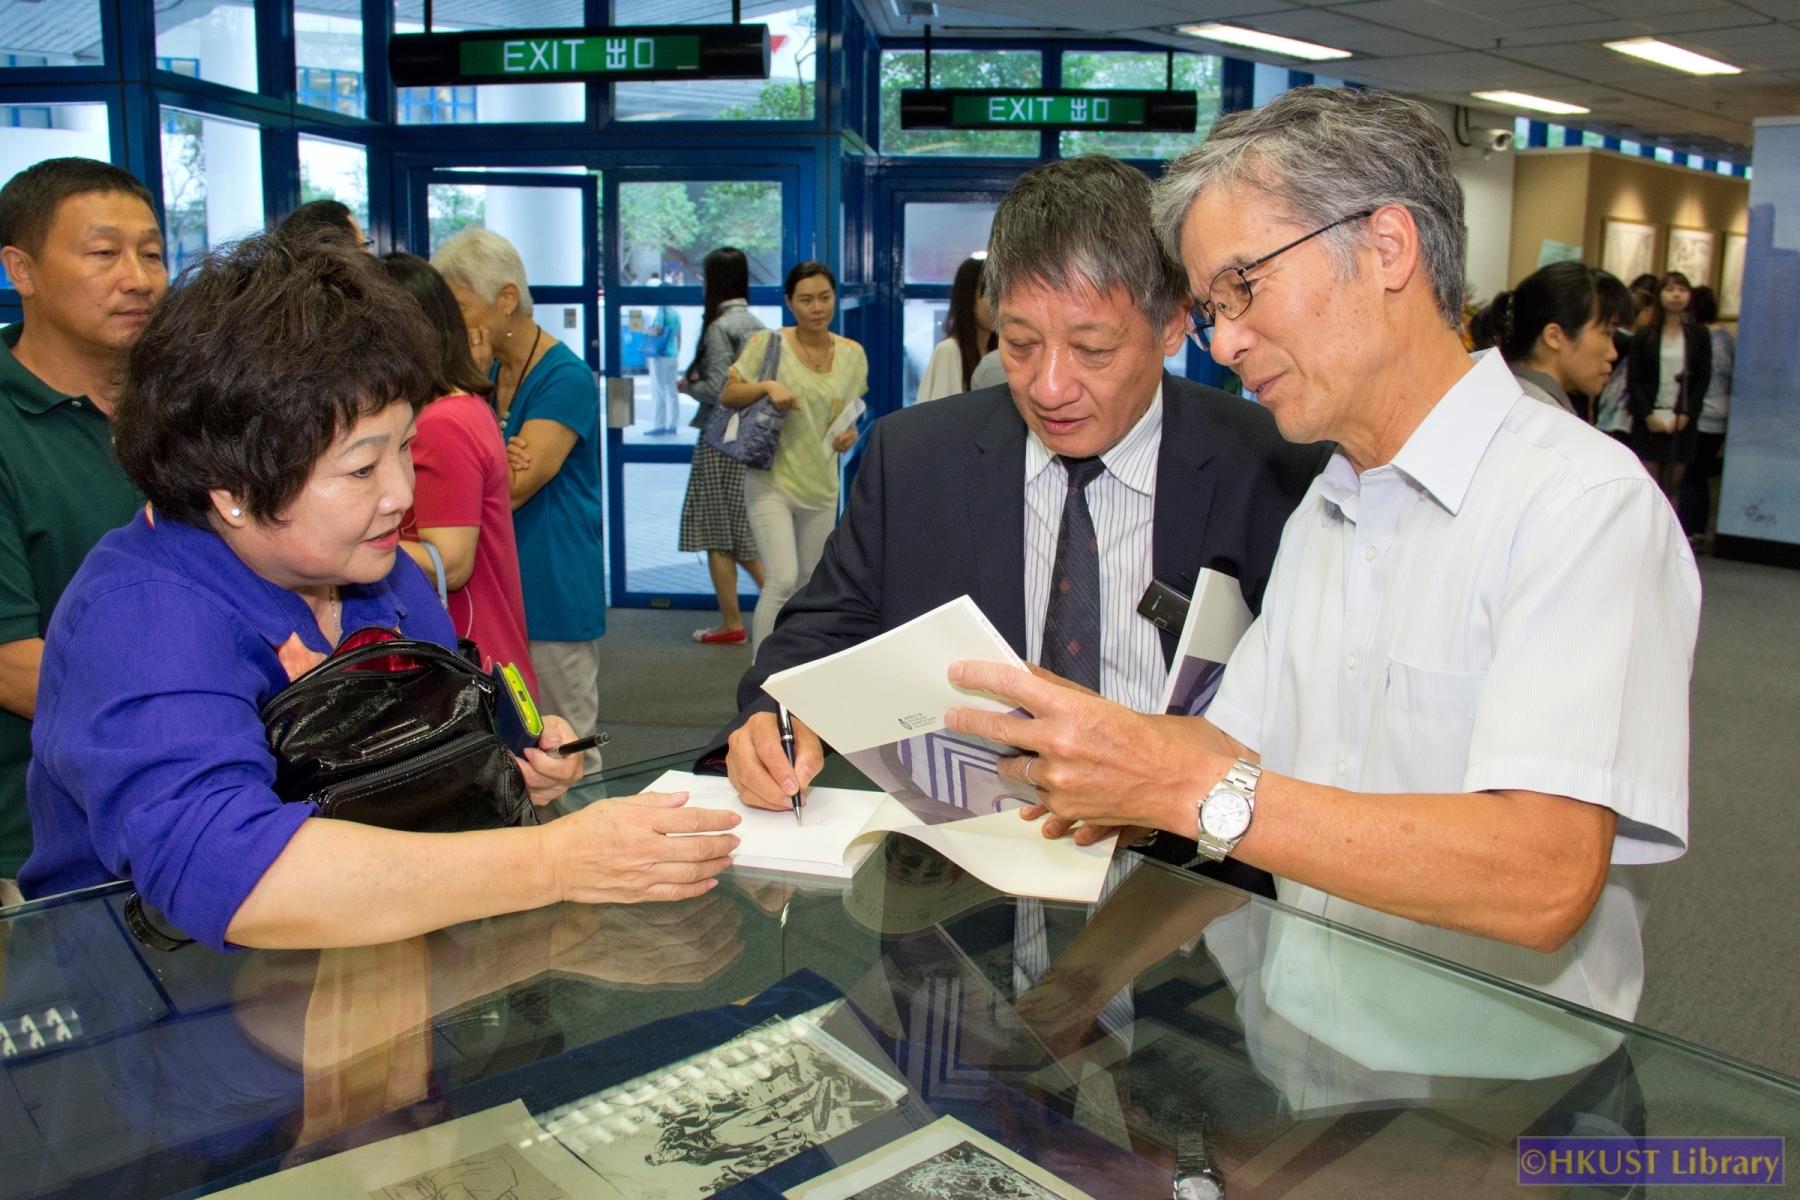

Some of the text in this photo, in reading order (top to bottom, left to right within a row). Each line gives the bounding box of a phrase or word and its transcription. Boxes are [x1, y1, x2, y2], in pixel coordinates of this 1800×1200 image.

[503, 38, 654, 72] EXIT 出口
[989, 97, 1109, 122] EXIT 出口
